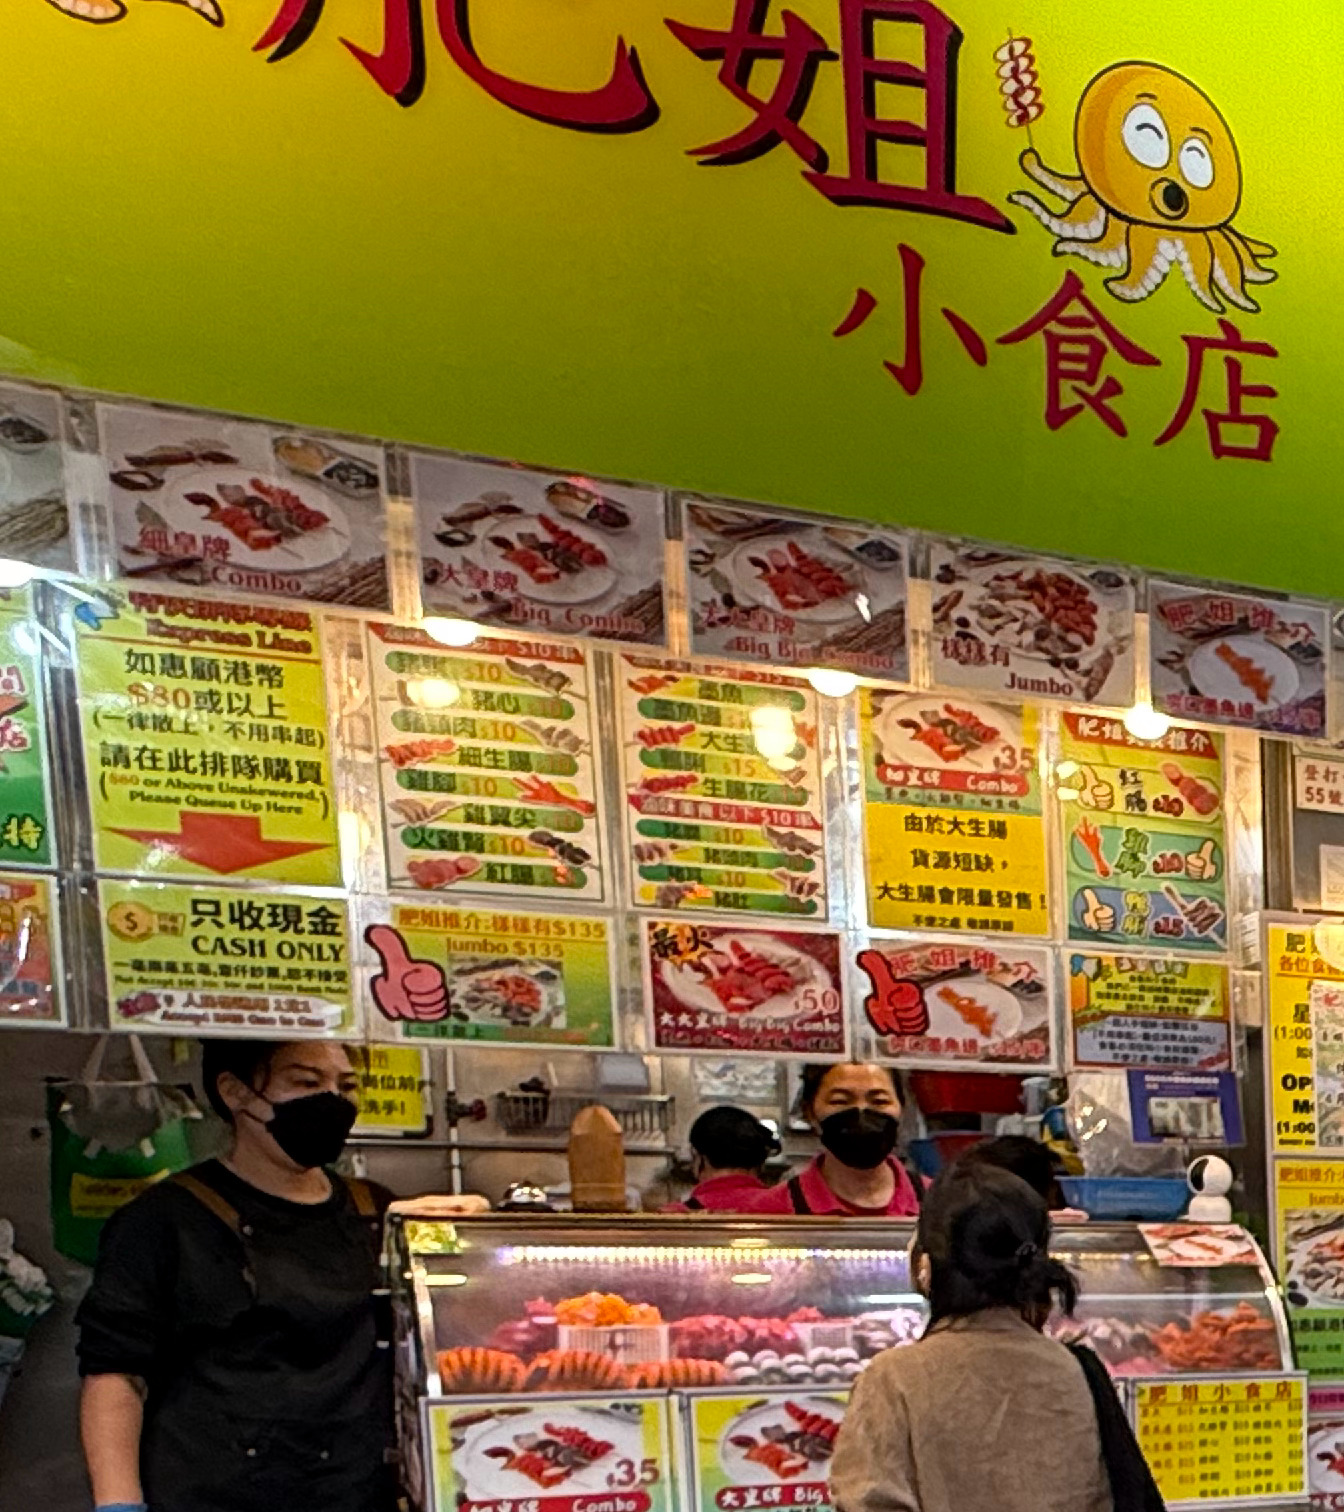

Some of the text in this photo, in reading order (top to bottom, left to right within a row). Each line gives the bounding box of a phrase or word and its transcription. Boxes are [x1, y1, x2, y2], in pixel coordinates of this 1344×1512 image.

[832, 242, 1280, 464] 小食店
[212, 567, 302, 591] Combo
[510, 601, 552, 627] Big
[736, 635, 770, 660] Big
[1005, 671, 1074, 697] Jumbo
[966, 776, 1019, 794] Combo
[189, 897, 344, 938] 只收現金
[190, 934, 345, 964] CASH ONLY
[446, 937, 564, 958] Jumbo $135
